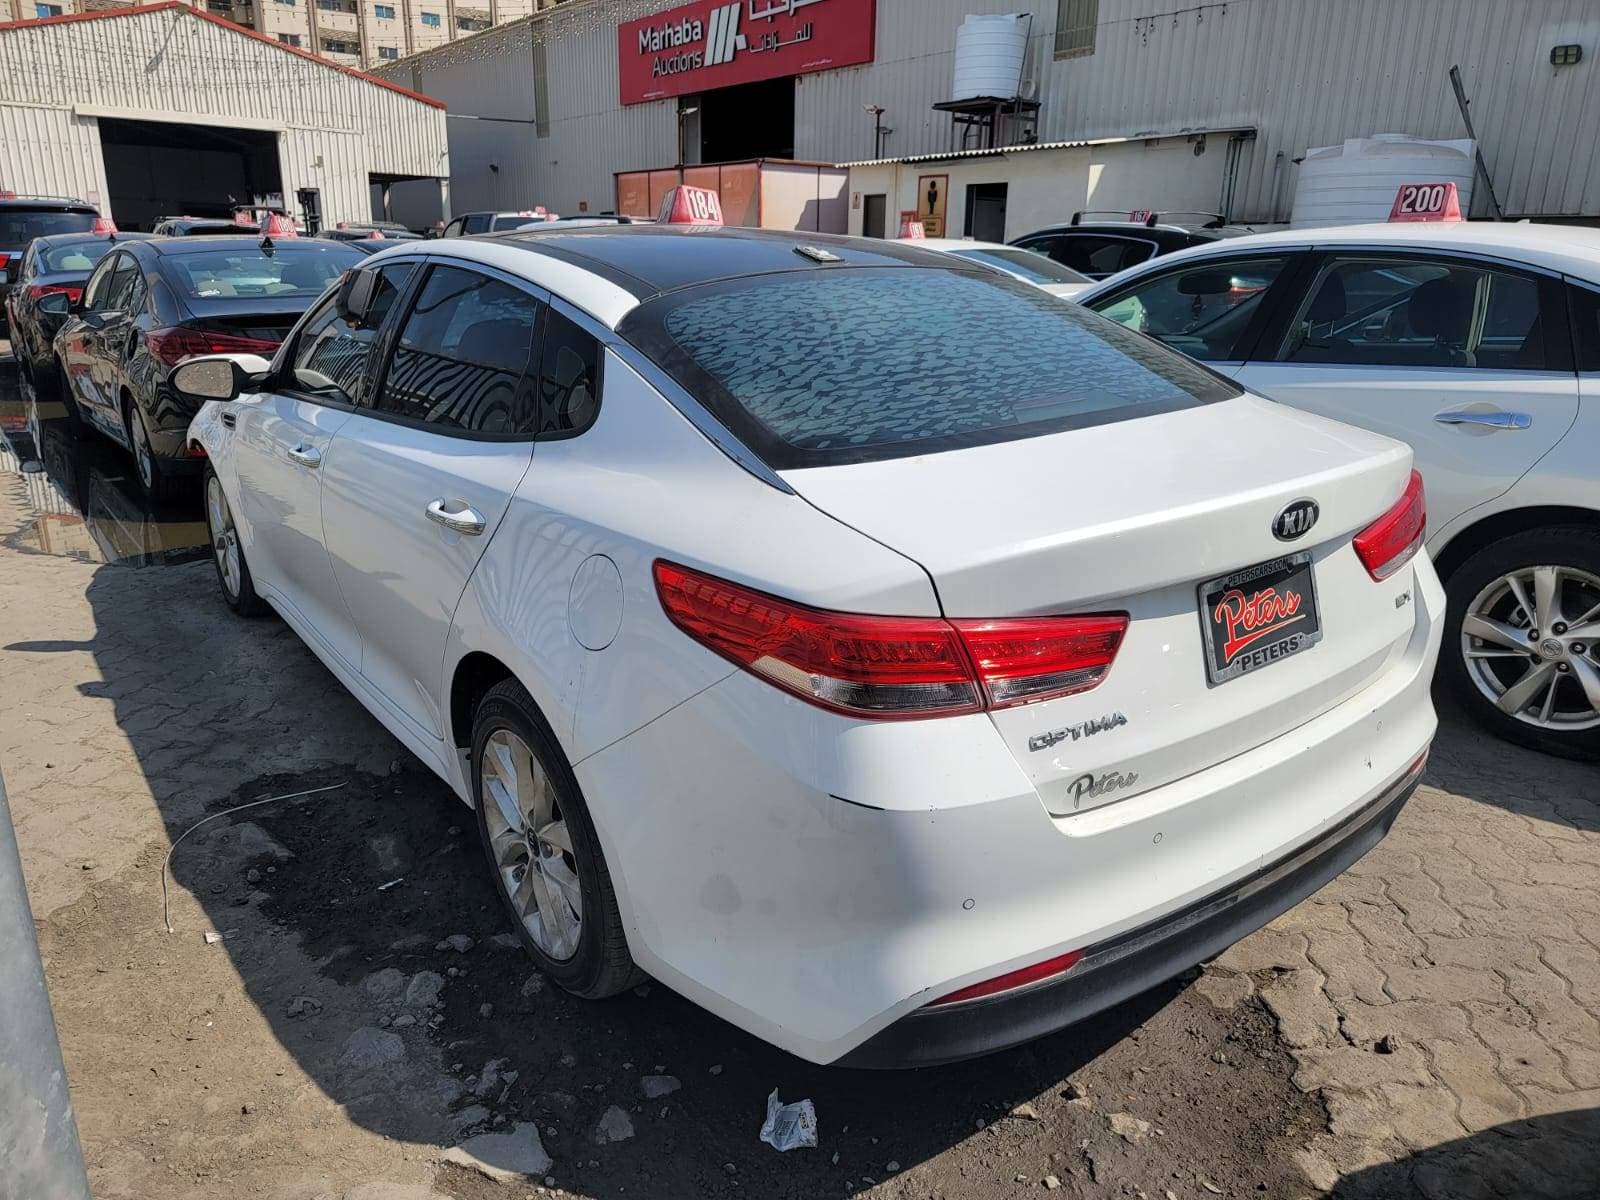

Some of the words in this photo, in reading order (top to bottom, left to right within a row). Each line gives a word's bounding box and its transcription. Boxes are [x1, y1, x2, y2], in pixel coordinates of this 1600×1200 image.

[749, 0, 826, 22] رحبا
[638, 17, 702, 54] Marhaba
[652, 52, 702, 79] Auctions
[690, 190, 719, 221] 184
[1401, 186, 1445, 213] 200
[1283, 506, 1316, 536] KIA
[1215, 588, 1302, 648] Peters
[1241, 636, 1300, 671] PETERS
[1028, 711, 1128, 752] OPTIMA
[1066, 773, 1139, 809] Peters
